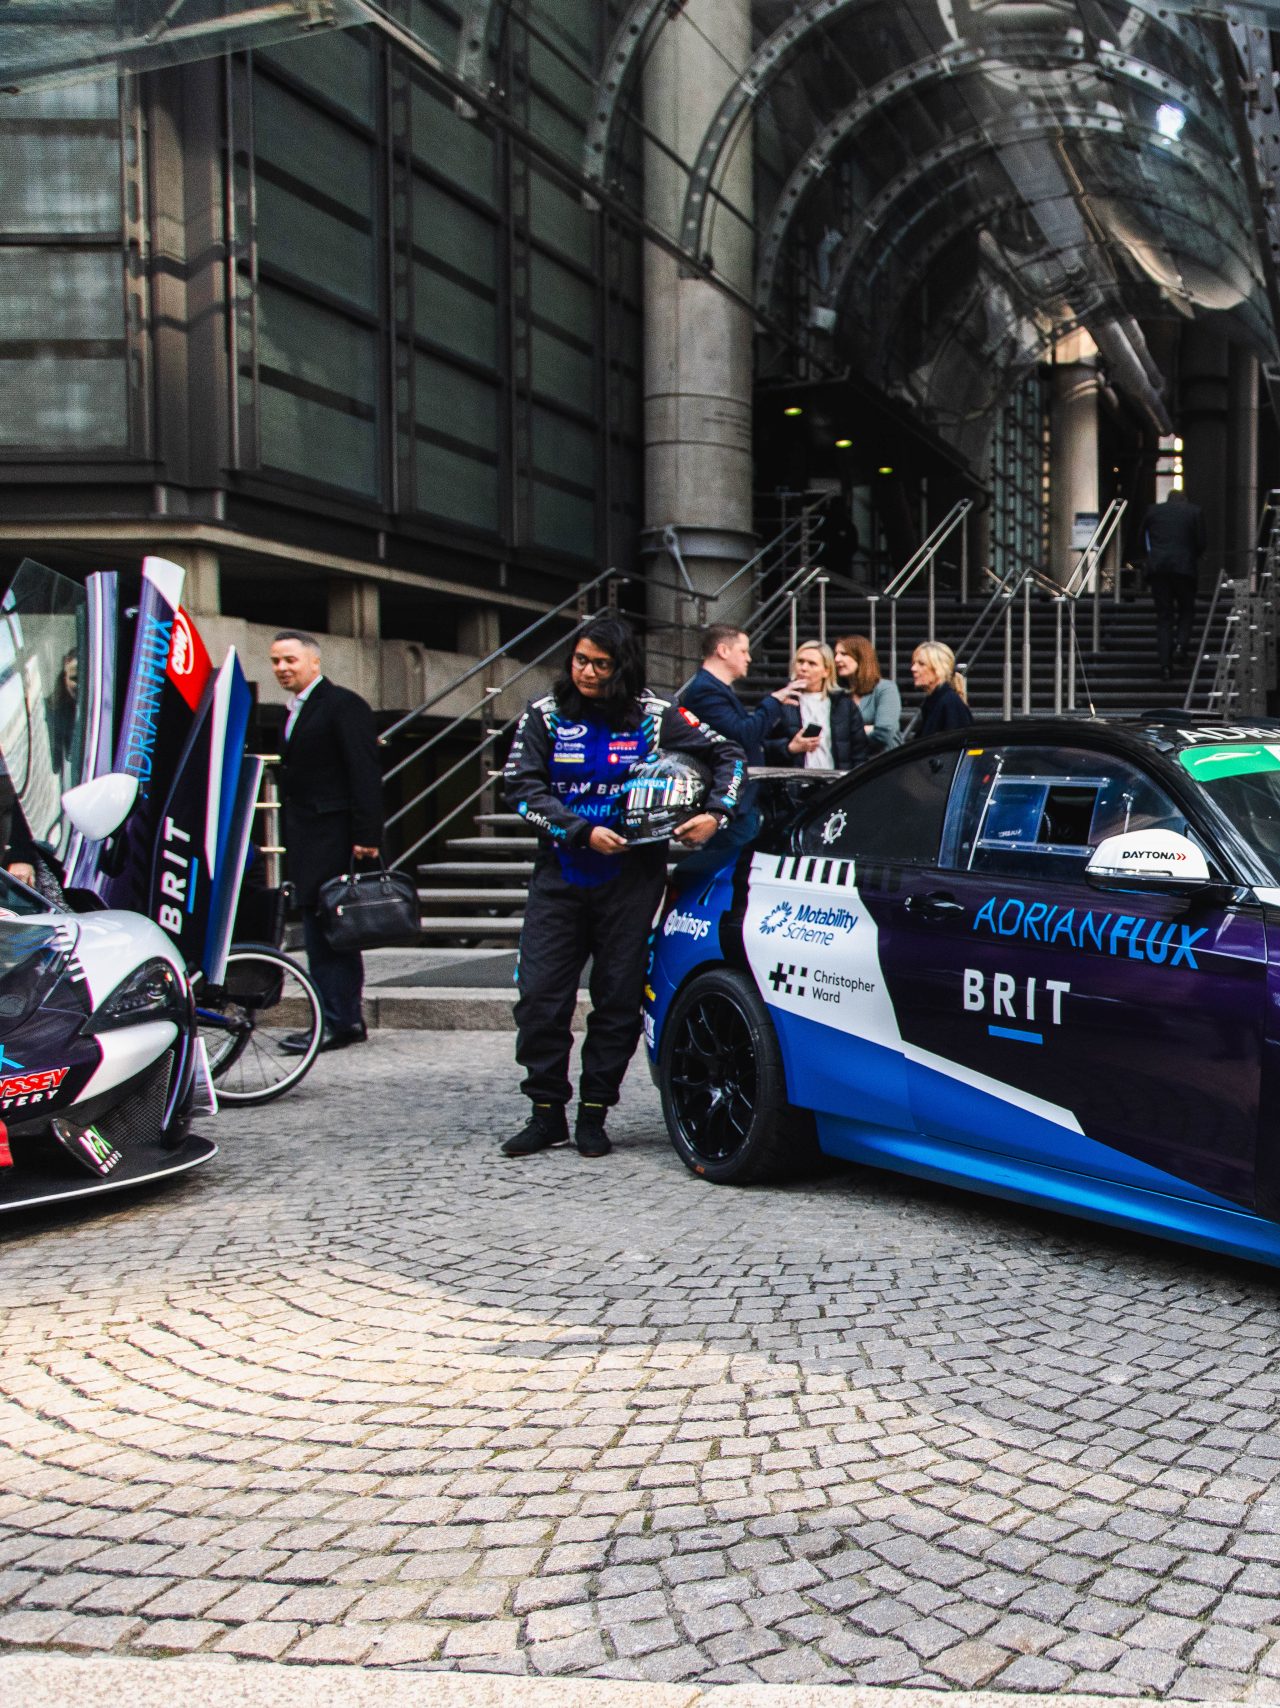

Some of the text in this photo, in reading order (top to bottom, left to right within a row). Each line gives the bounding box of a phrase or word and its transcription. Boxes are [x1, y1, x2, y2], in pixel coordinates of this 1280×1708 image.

[1121, 850, 1176, 860] DAYTONA
[158, 816, 191, 935] BRIT
[794, 904, 859, 934] Motability
[782, 922, 835, 946] Scheme
[813, 969, 875, 993] Christopher
[812, 986, 841, 1004] Ward
[963, 968, 1071, 1025] BRIT
